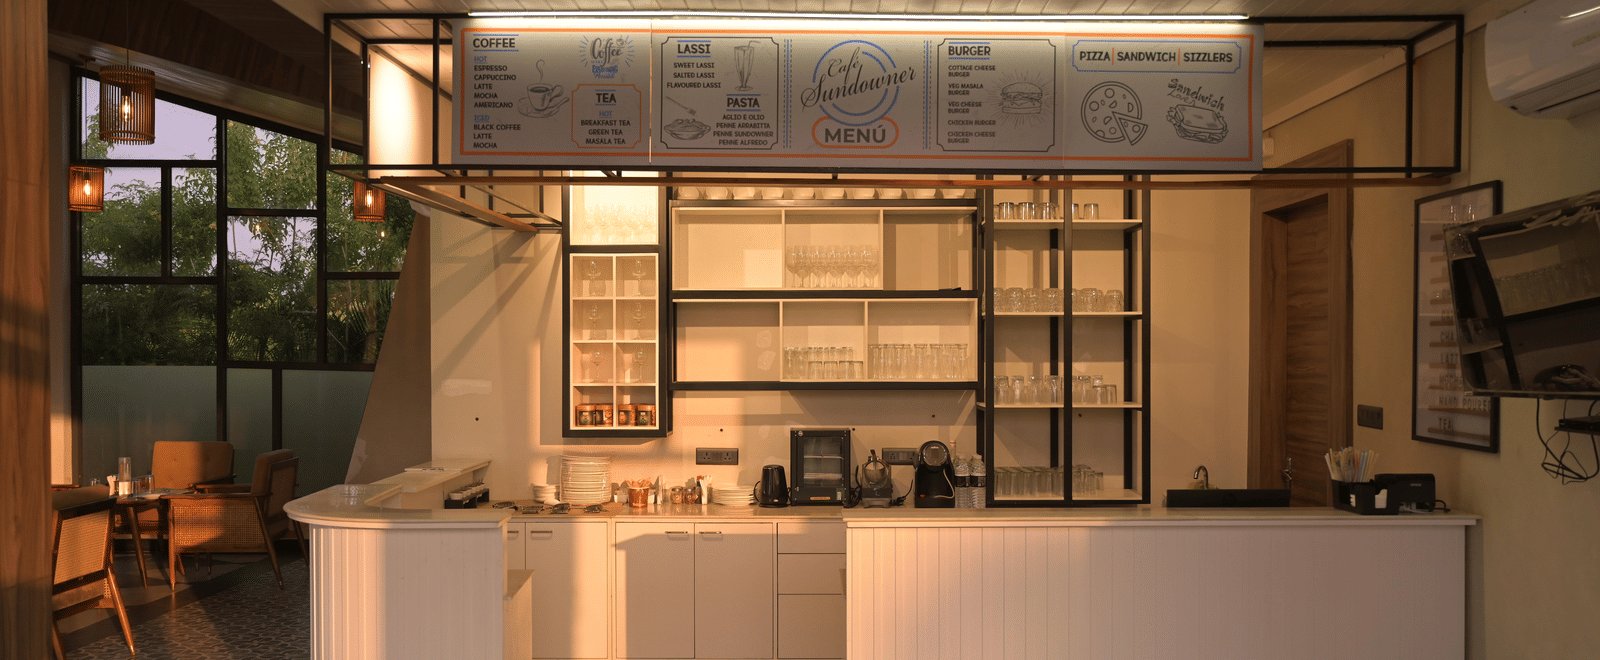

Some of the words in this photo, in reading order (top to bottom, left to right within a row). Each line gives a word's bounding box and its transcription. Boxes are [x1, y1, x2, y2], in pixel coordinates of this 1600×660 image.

[473, 38, 516, 48] COFFEE
[591, 38, 623, 67] Coffee
[678, 44, 710, 54] LASSI
[948, 46, 991, 56] BURGER
[1080, 52, 1111, 61] PIZZA
[1117, 52, 1176, 62] SANDWICH
[1184, 52, 1233, 63] SIZZLERS
[827, 47, 861, 84] Café
[801, 64, 916, 113] Sundowner
[596, 93, 617, 103] TEA
[1168, 78, 1225, 111] Sandwich
[727, 98, 760, 108] PASTA
[825, 124, 886, 143] MENÚ
